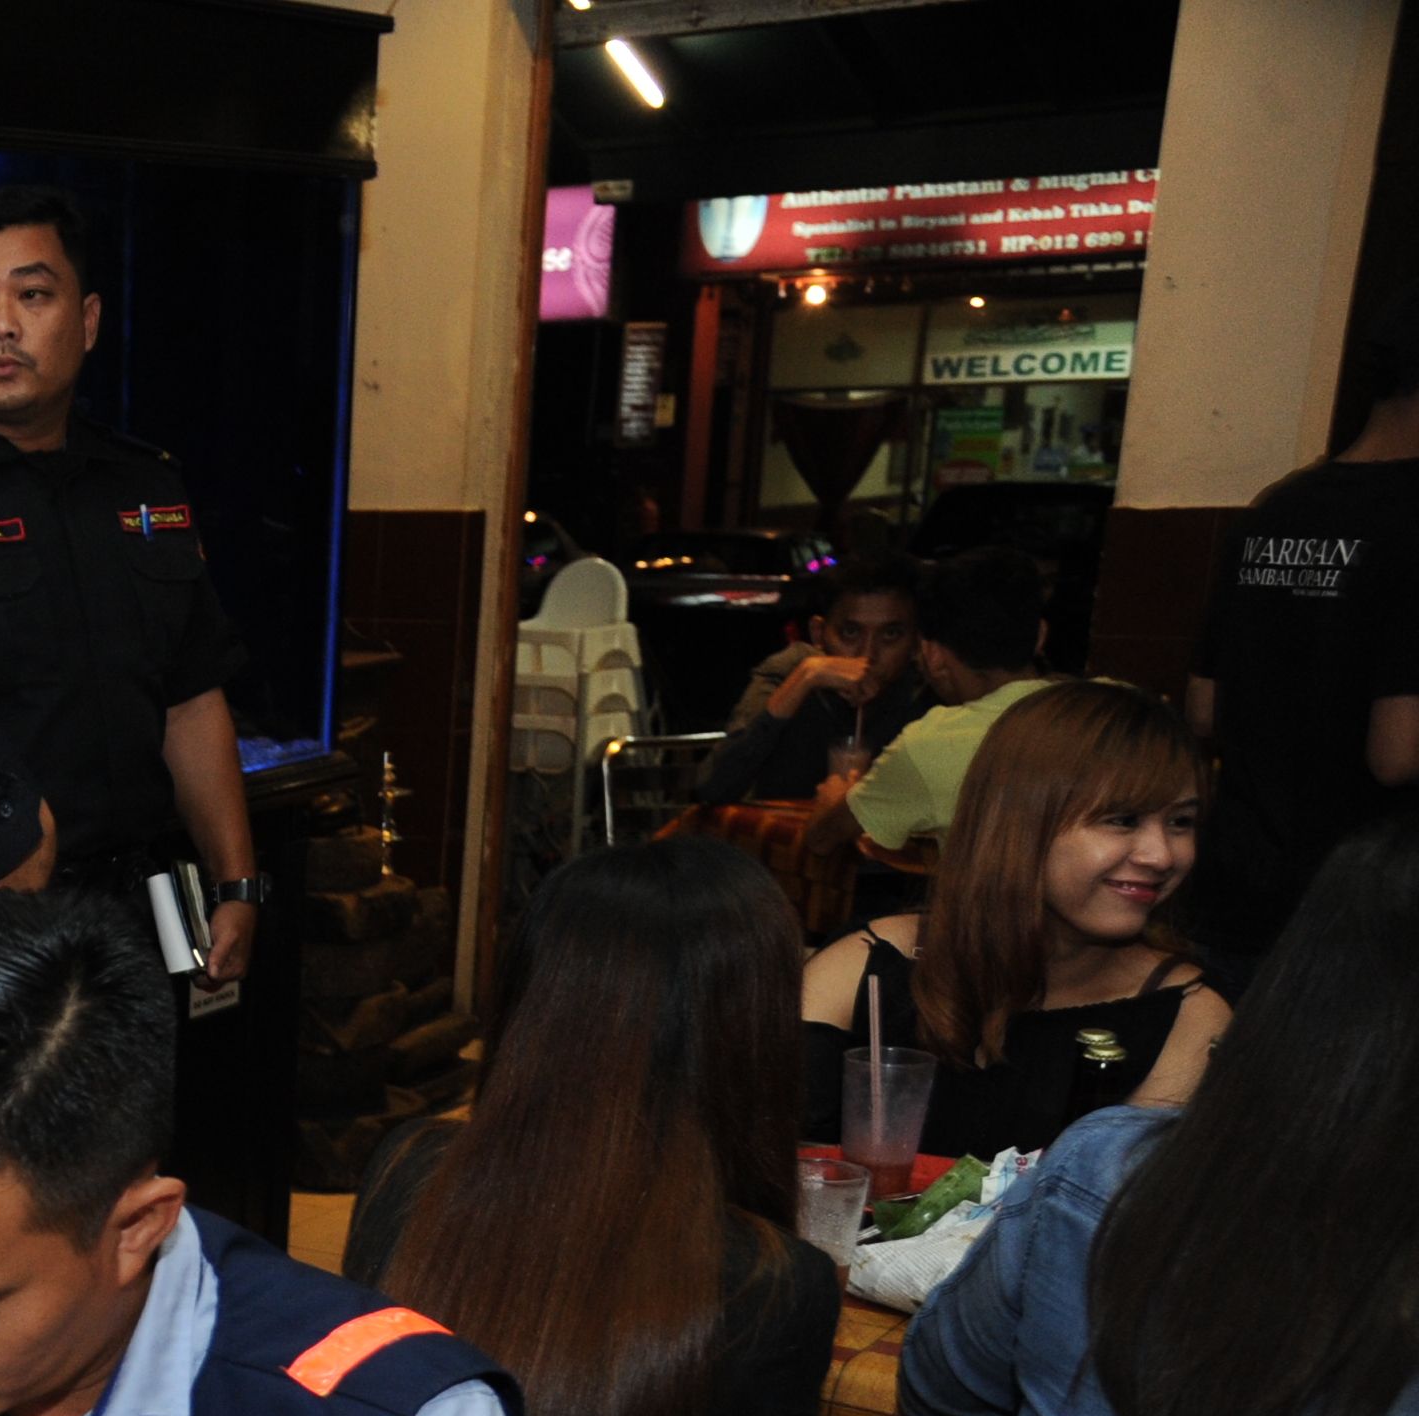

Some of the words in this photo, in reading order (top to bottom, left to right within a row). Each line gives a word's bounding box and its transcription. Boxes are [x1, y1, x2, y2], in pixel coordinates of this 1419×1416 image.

[931, 350, 1128, 379] WELCOME
[1242, 536, 1361, 566] WARISAN
[1237, 567, 1295, 586] SAMBAL
